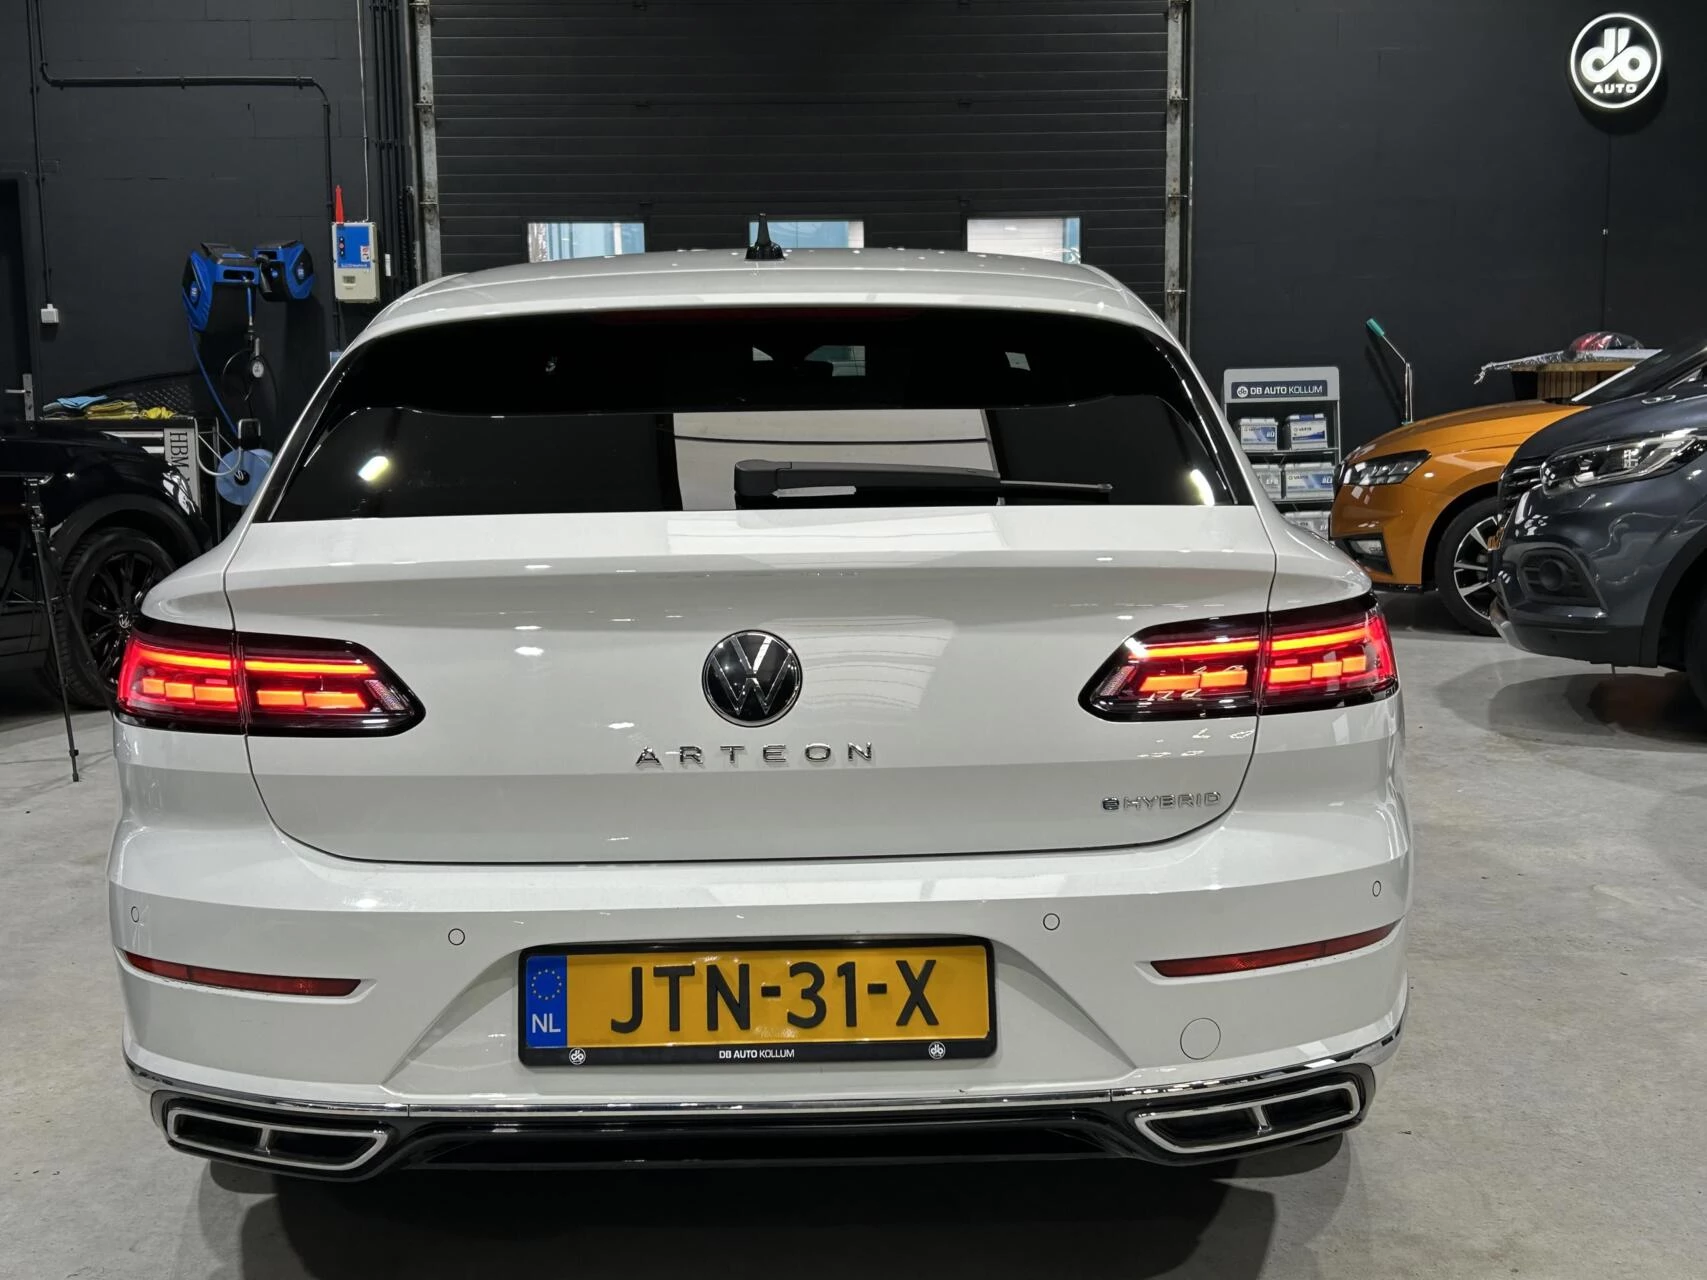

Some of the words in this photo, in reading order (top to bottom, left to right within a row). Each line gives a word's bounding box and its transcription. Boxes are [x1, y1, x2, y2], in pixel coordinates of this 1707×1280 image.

[1593, 83, 1638, 94] AUTO
[1250, 387, 1262, 395] DB
[1264, 386, 1287, 395] AUTO
[1289, 385, 1323, 394] KOLLUM
[170, 432, 189, 468] HBM
[635, 742, 873, 766] ARTEON
[610, 959, 939, 1035] JTN-31-X
[532, 1013, 561, 1034] NL
[719, 1050, 732, 1059] DB
[733, 1049, 758, 1059] AUTO
[759, 1049, 795, 1058] KOLLUM
